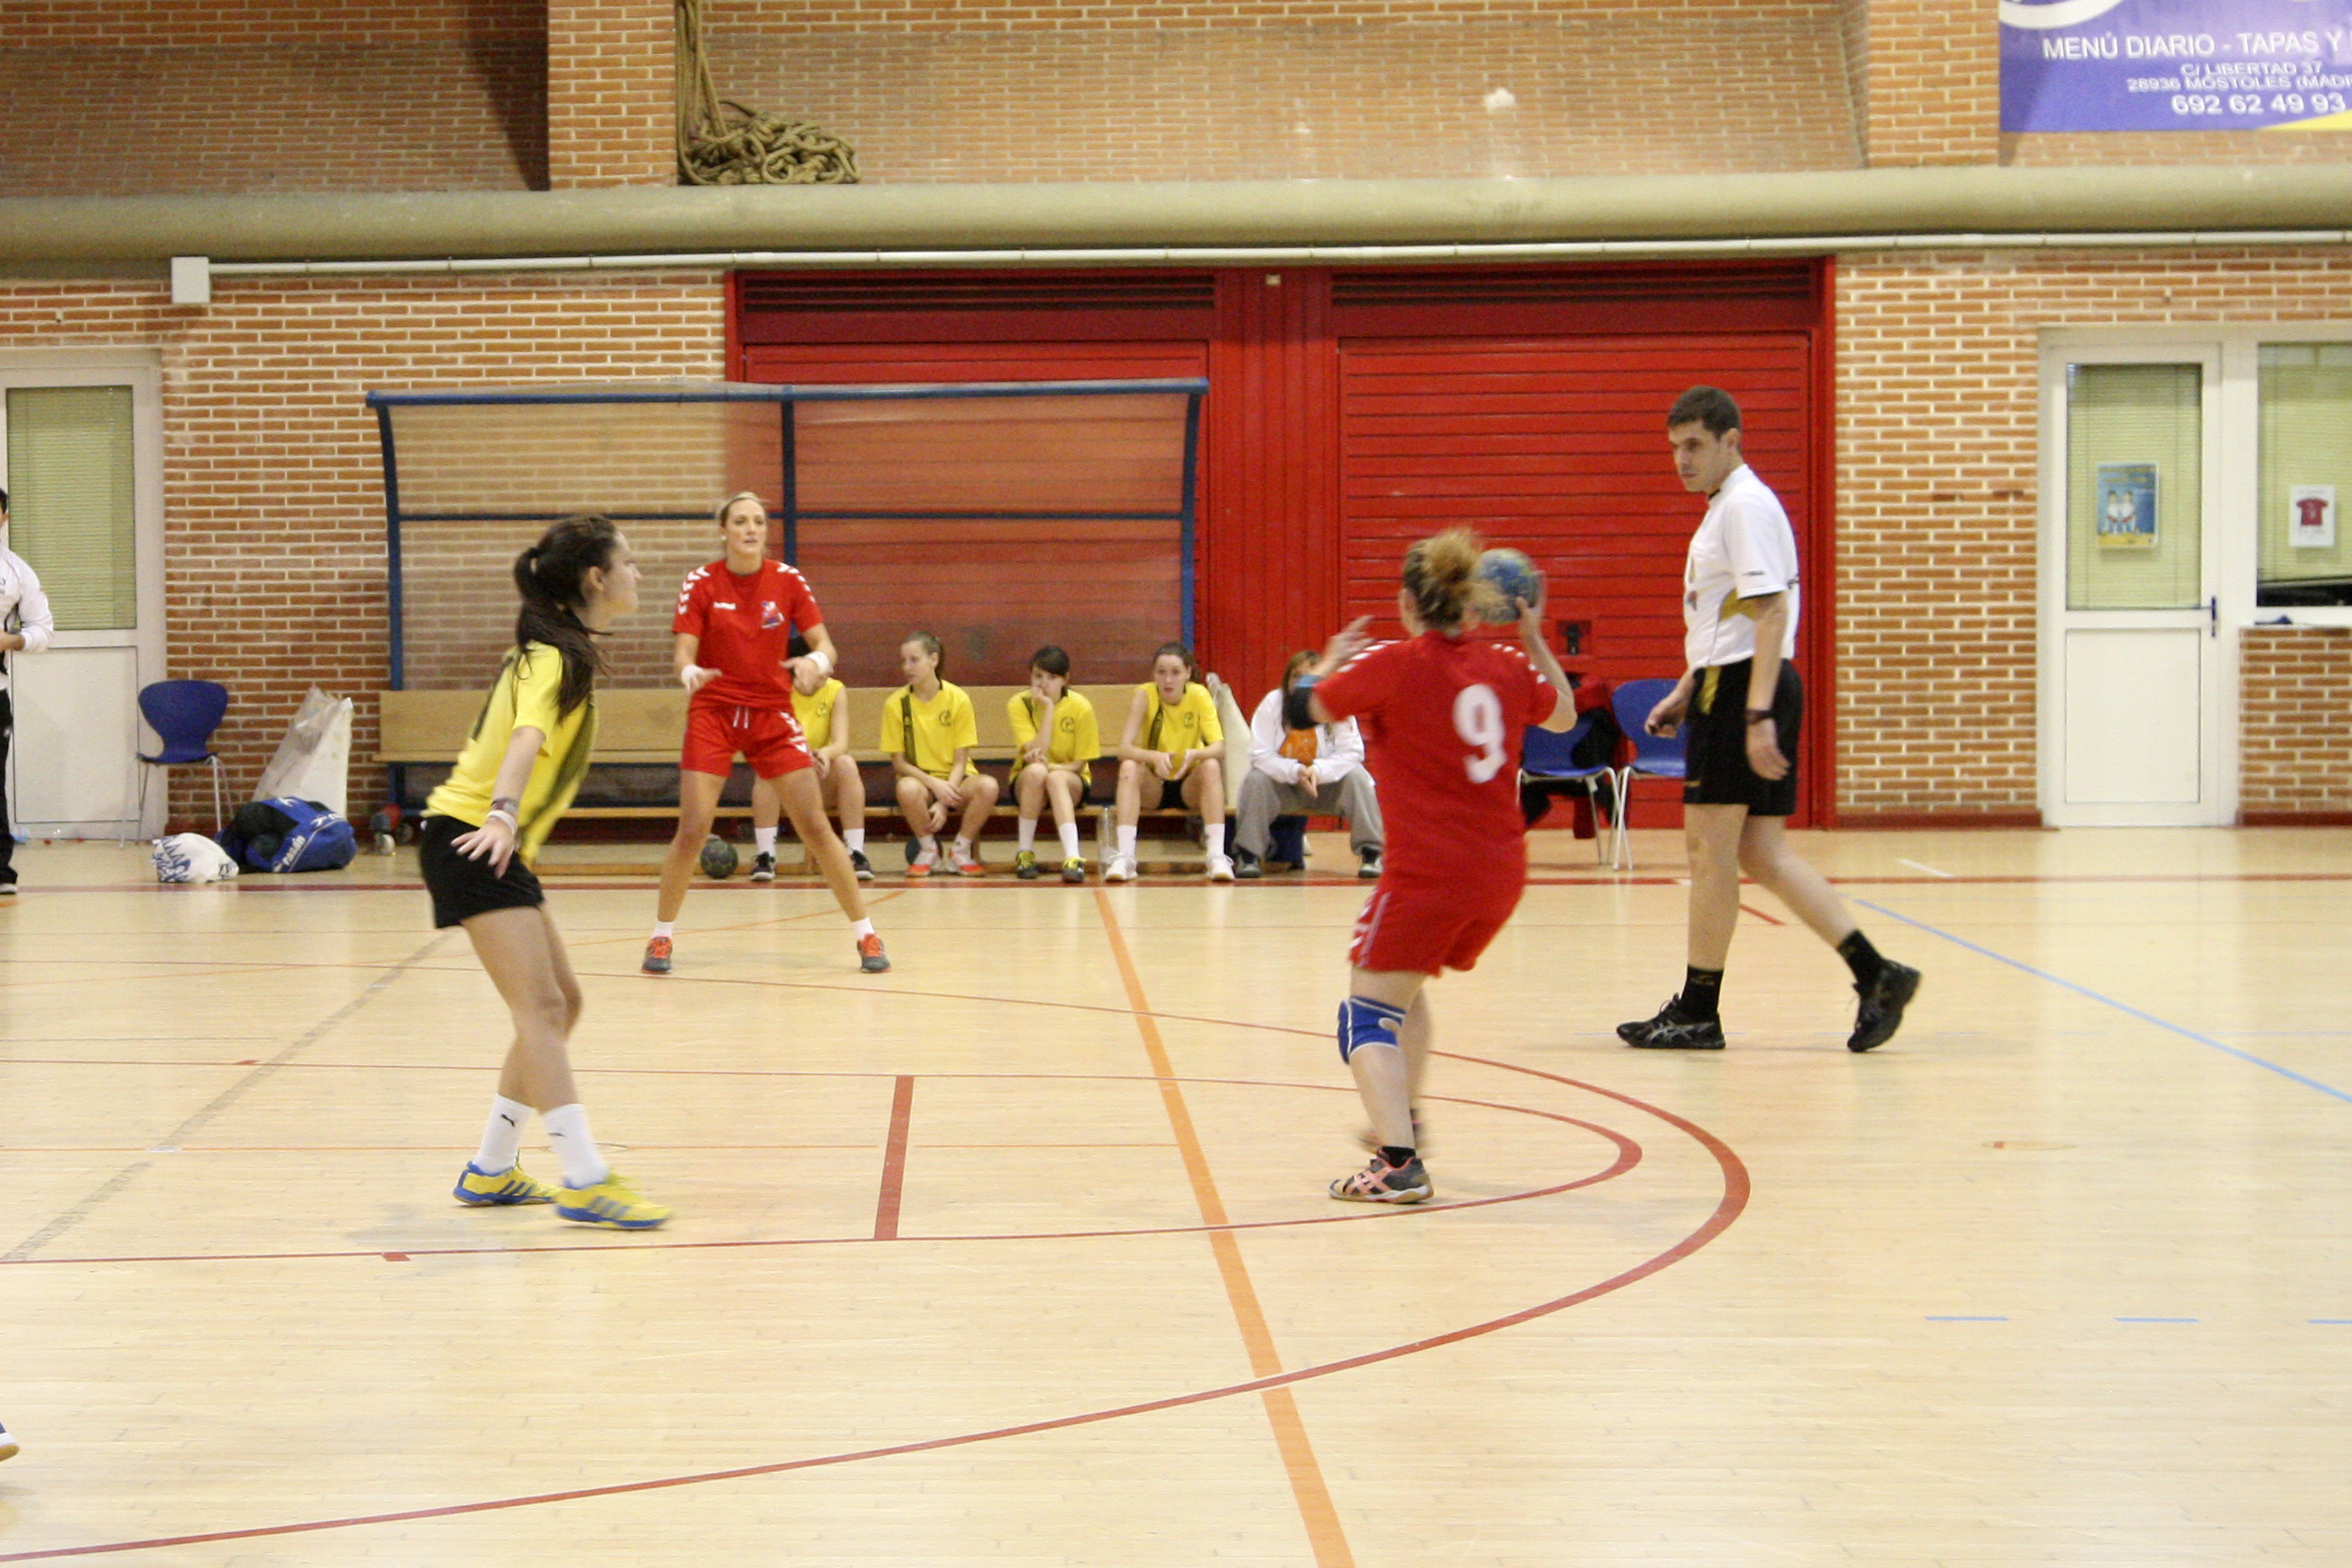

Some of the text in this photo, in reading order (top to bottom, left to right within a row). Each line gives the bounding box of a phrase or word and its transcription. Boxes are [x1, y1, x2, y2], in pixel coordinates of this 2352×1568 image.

[2042, 31, 2118, 59] MENÚ
[2126, 34, 2215, 59] DIARIO
[2237, 31, 2320, 56] TAPAS
[2324, 30, 2343, 54] Y
[2204, 62, 2298, 76] LIBERTAD
[2171, 91, 2347, 115] 692 62 49 93
[1452, 683, 1508, 783] 9
